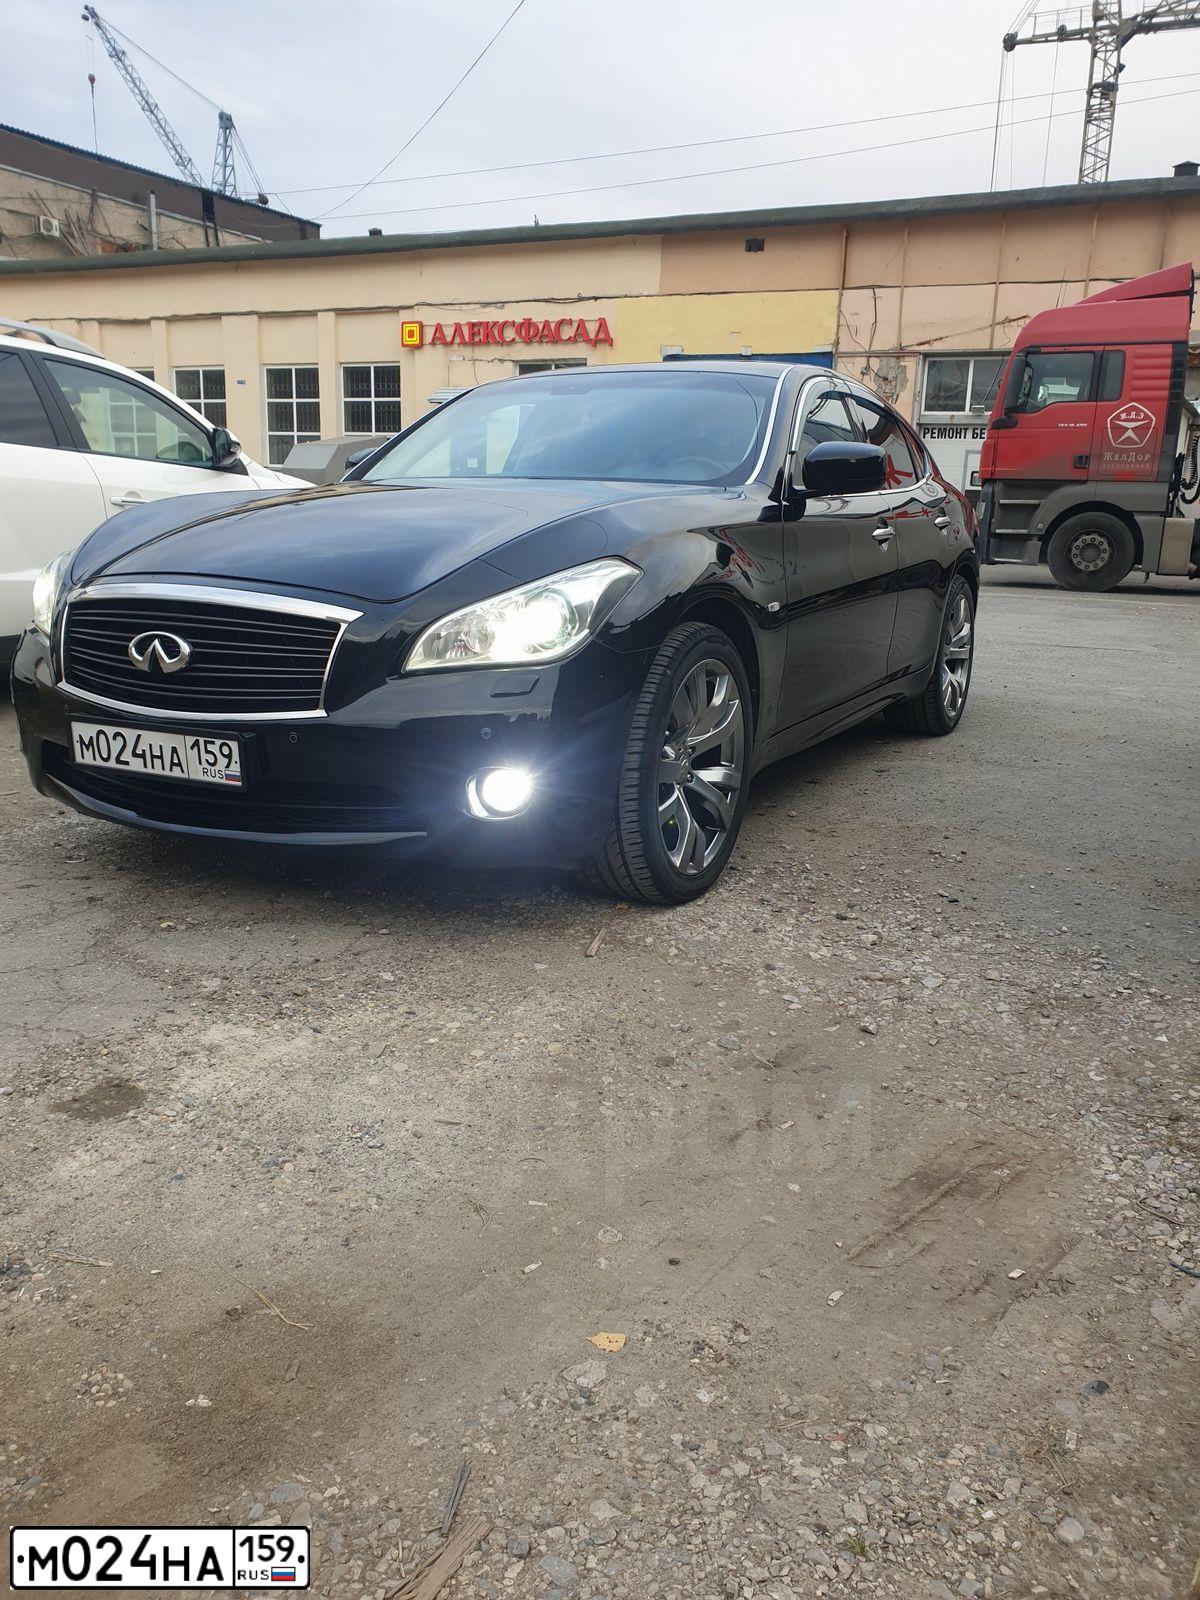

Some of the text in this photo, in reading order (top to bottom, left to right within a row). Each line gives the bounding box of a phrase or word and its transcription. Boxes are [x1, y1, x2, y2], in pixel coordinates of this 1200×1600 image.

[429, 317, 613, 347] АЛЕКСФАСАД
[922, 427, 969, 440] РЕМОНТ
[190, 738, 233, 769] 159
[202, 767, 225, 780] RUS
